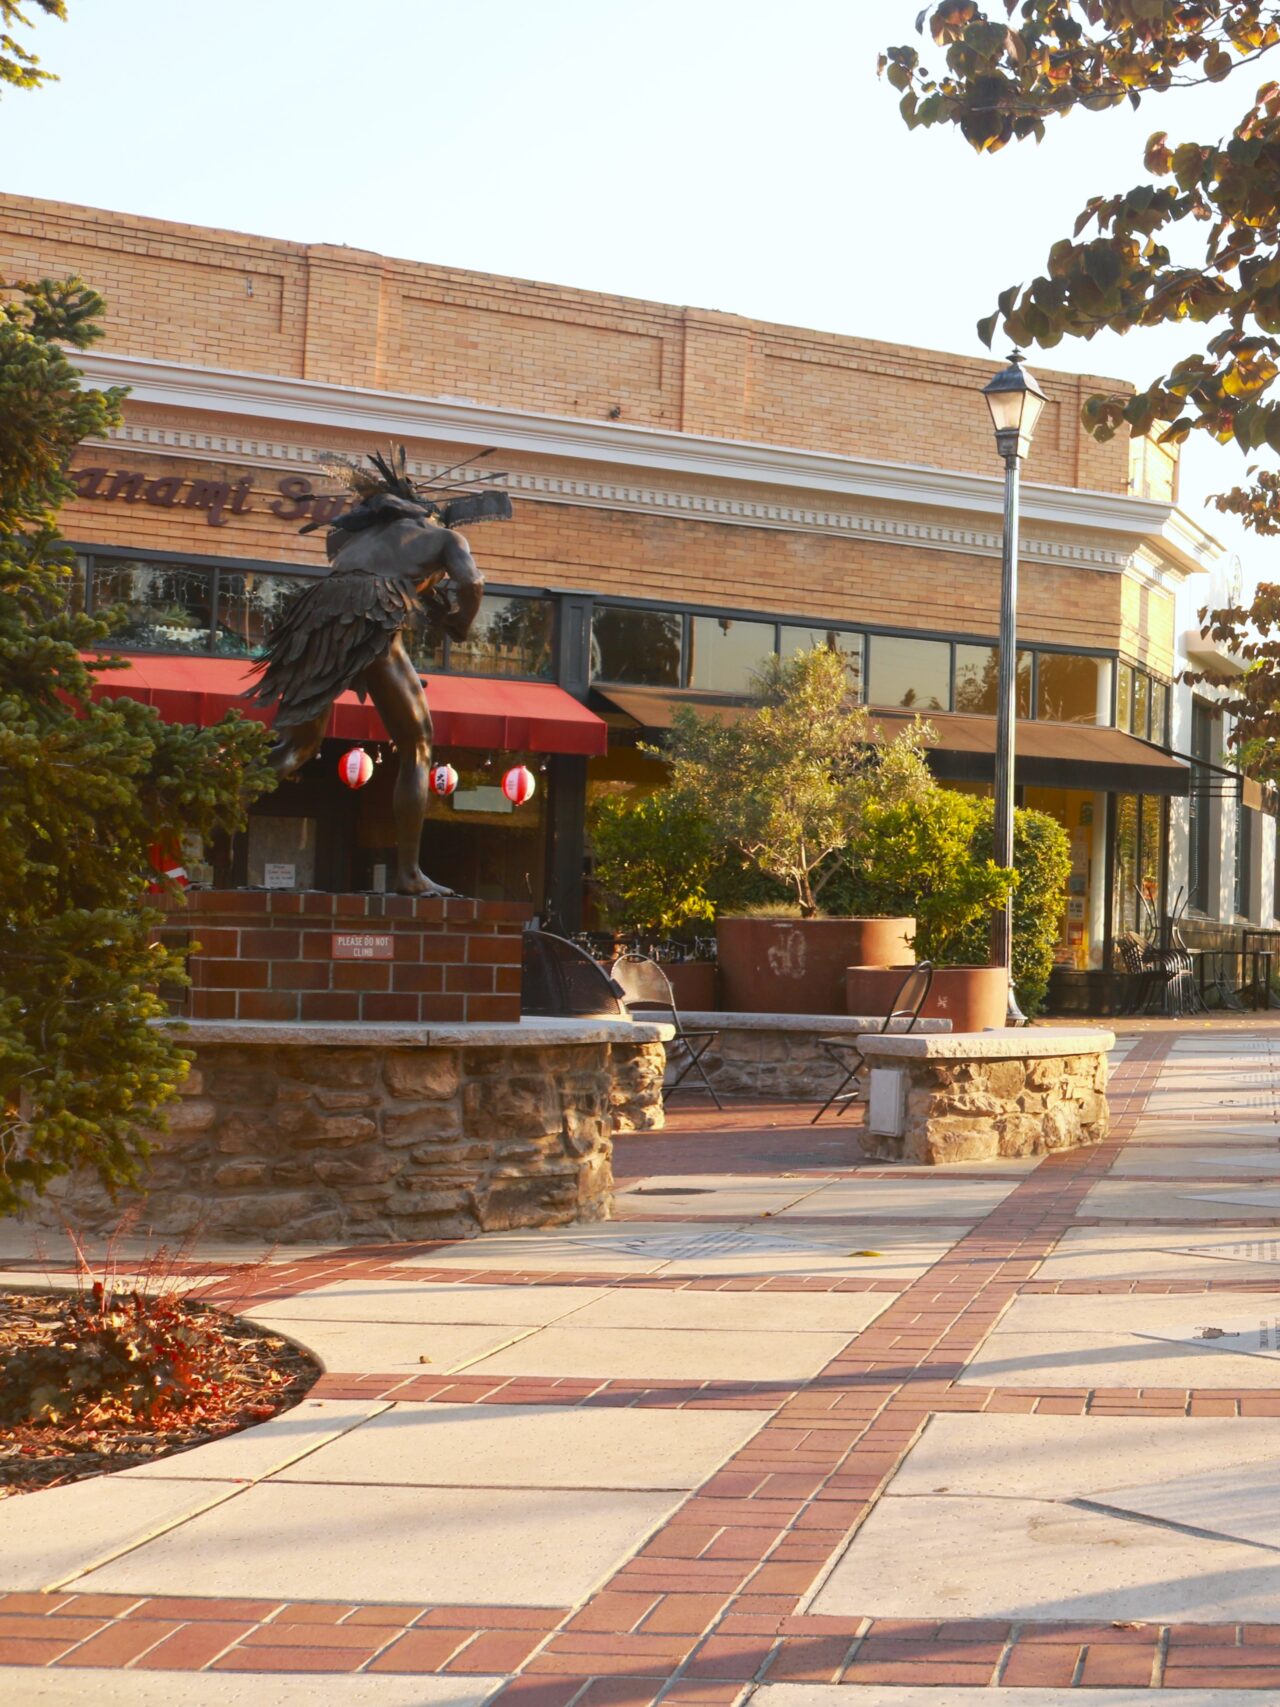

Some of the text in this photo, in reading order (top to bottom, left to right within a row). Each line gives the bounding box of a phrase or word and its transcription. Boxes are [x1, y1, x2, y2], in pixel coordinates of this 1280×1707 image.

[63, 453, 255, 527] anami
[337, 936, 389, 946] PLEASE DO NOT
[353, 947, 374, 957] CLIMB
